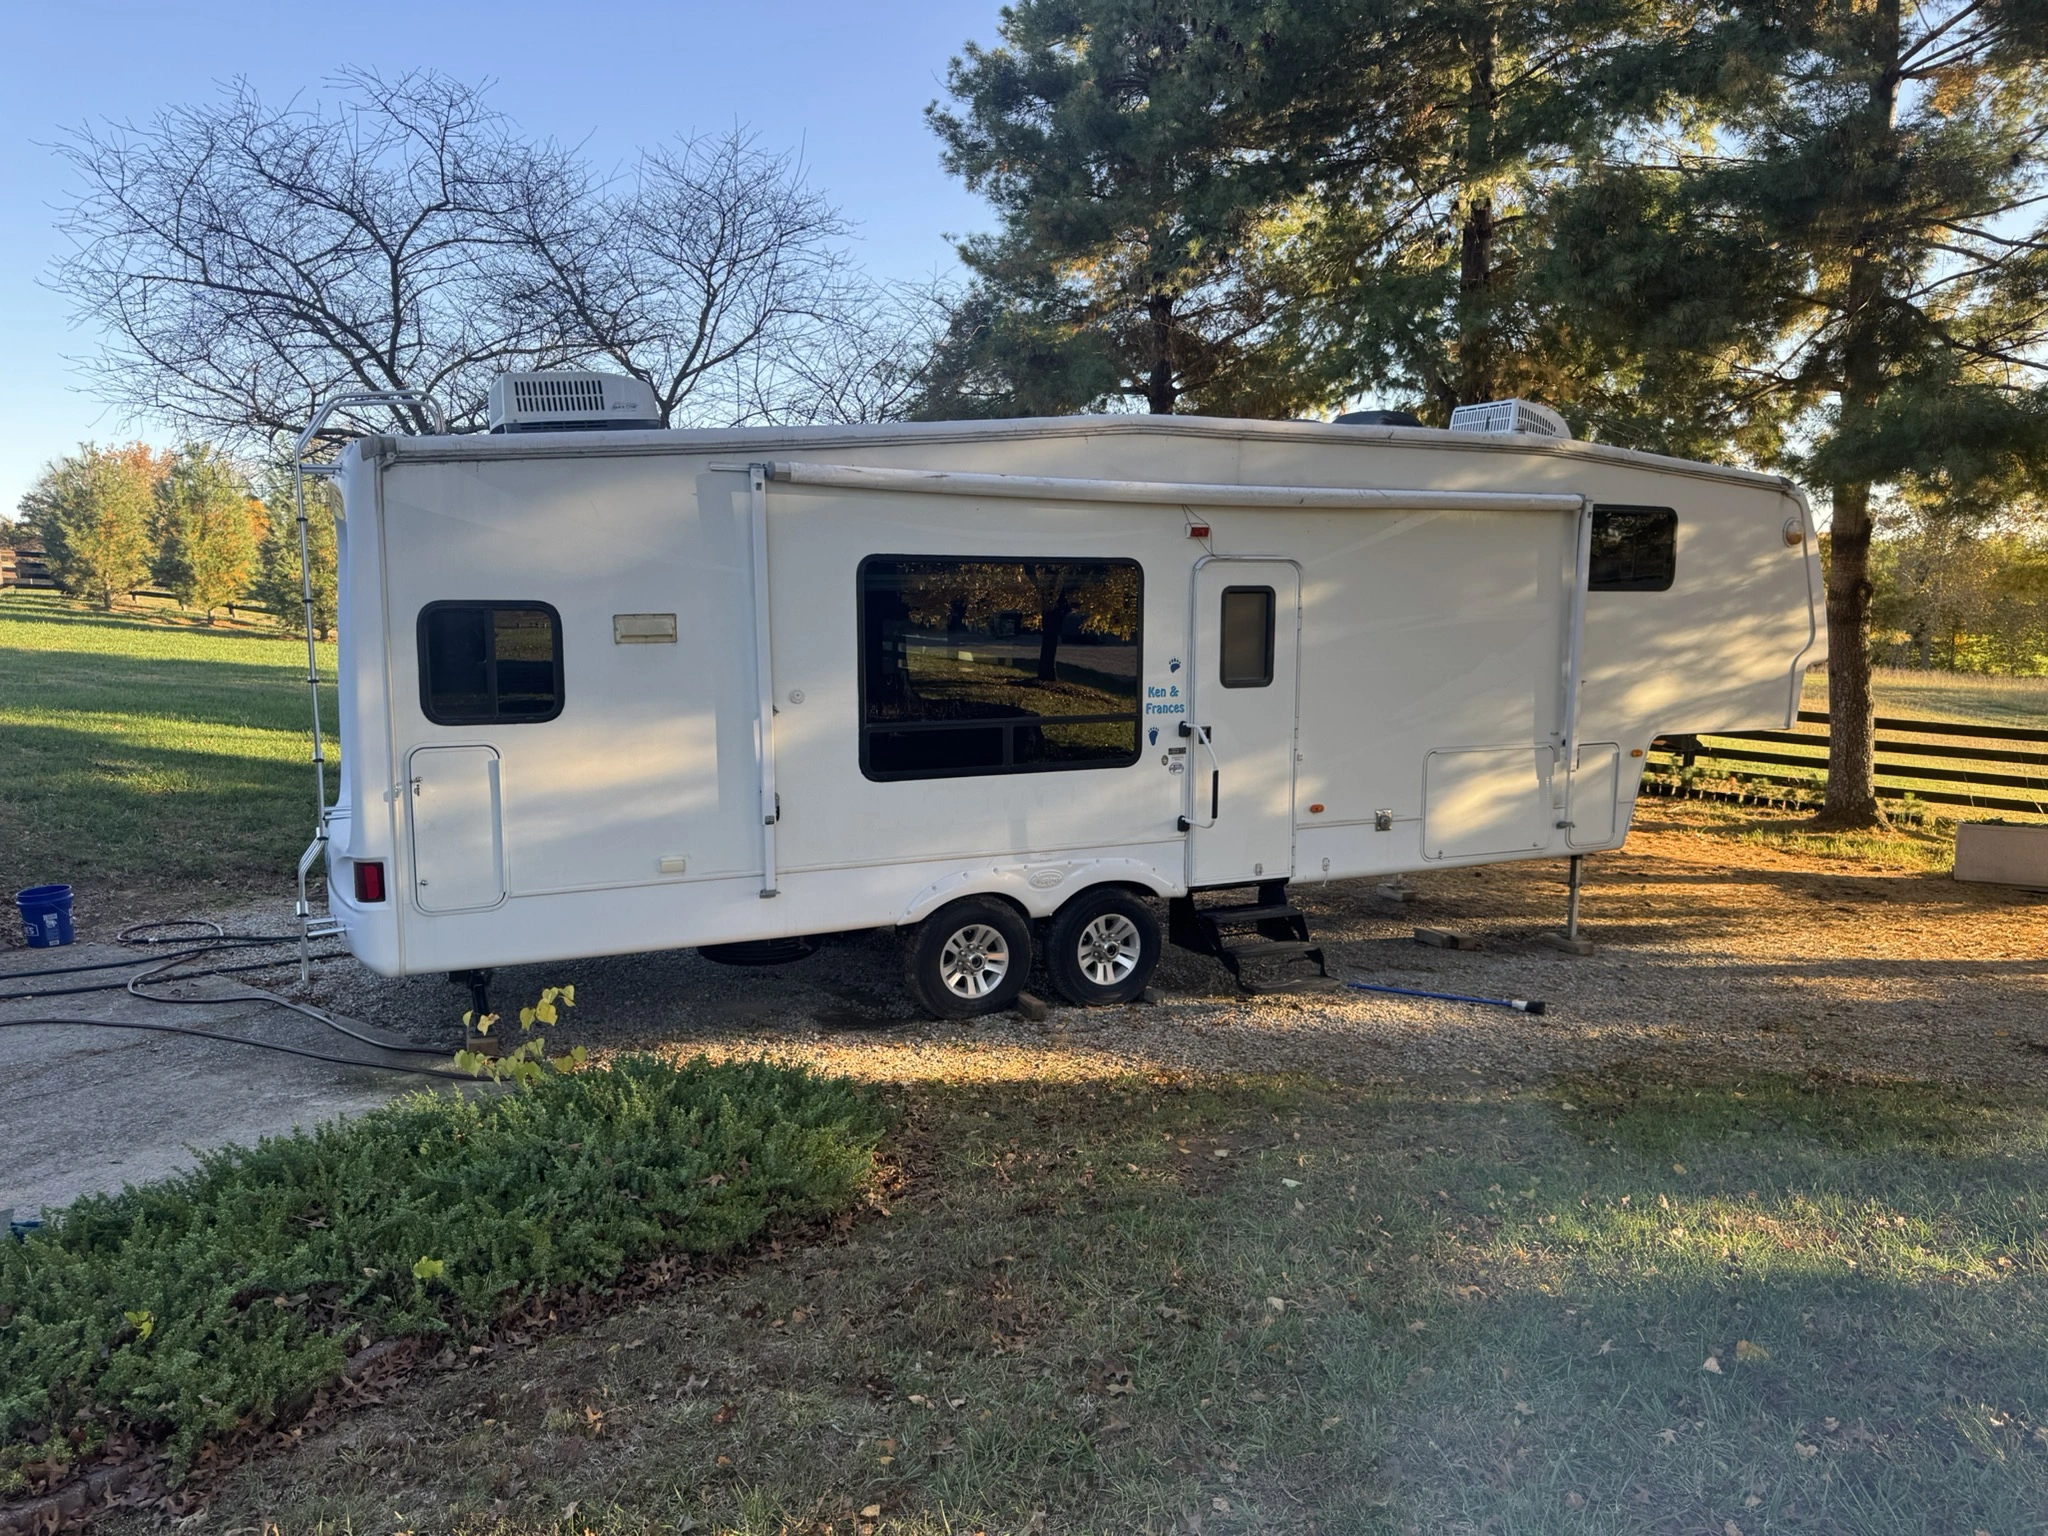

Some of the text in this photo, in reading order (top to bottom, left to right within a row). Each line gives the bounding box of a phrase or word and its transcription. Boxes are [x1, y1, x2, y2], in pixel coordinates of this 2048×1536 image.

[1147, 685, 1180, 698] Ken &
[1145, 702, 1185, 715] Frances
